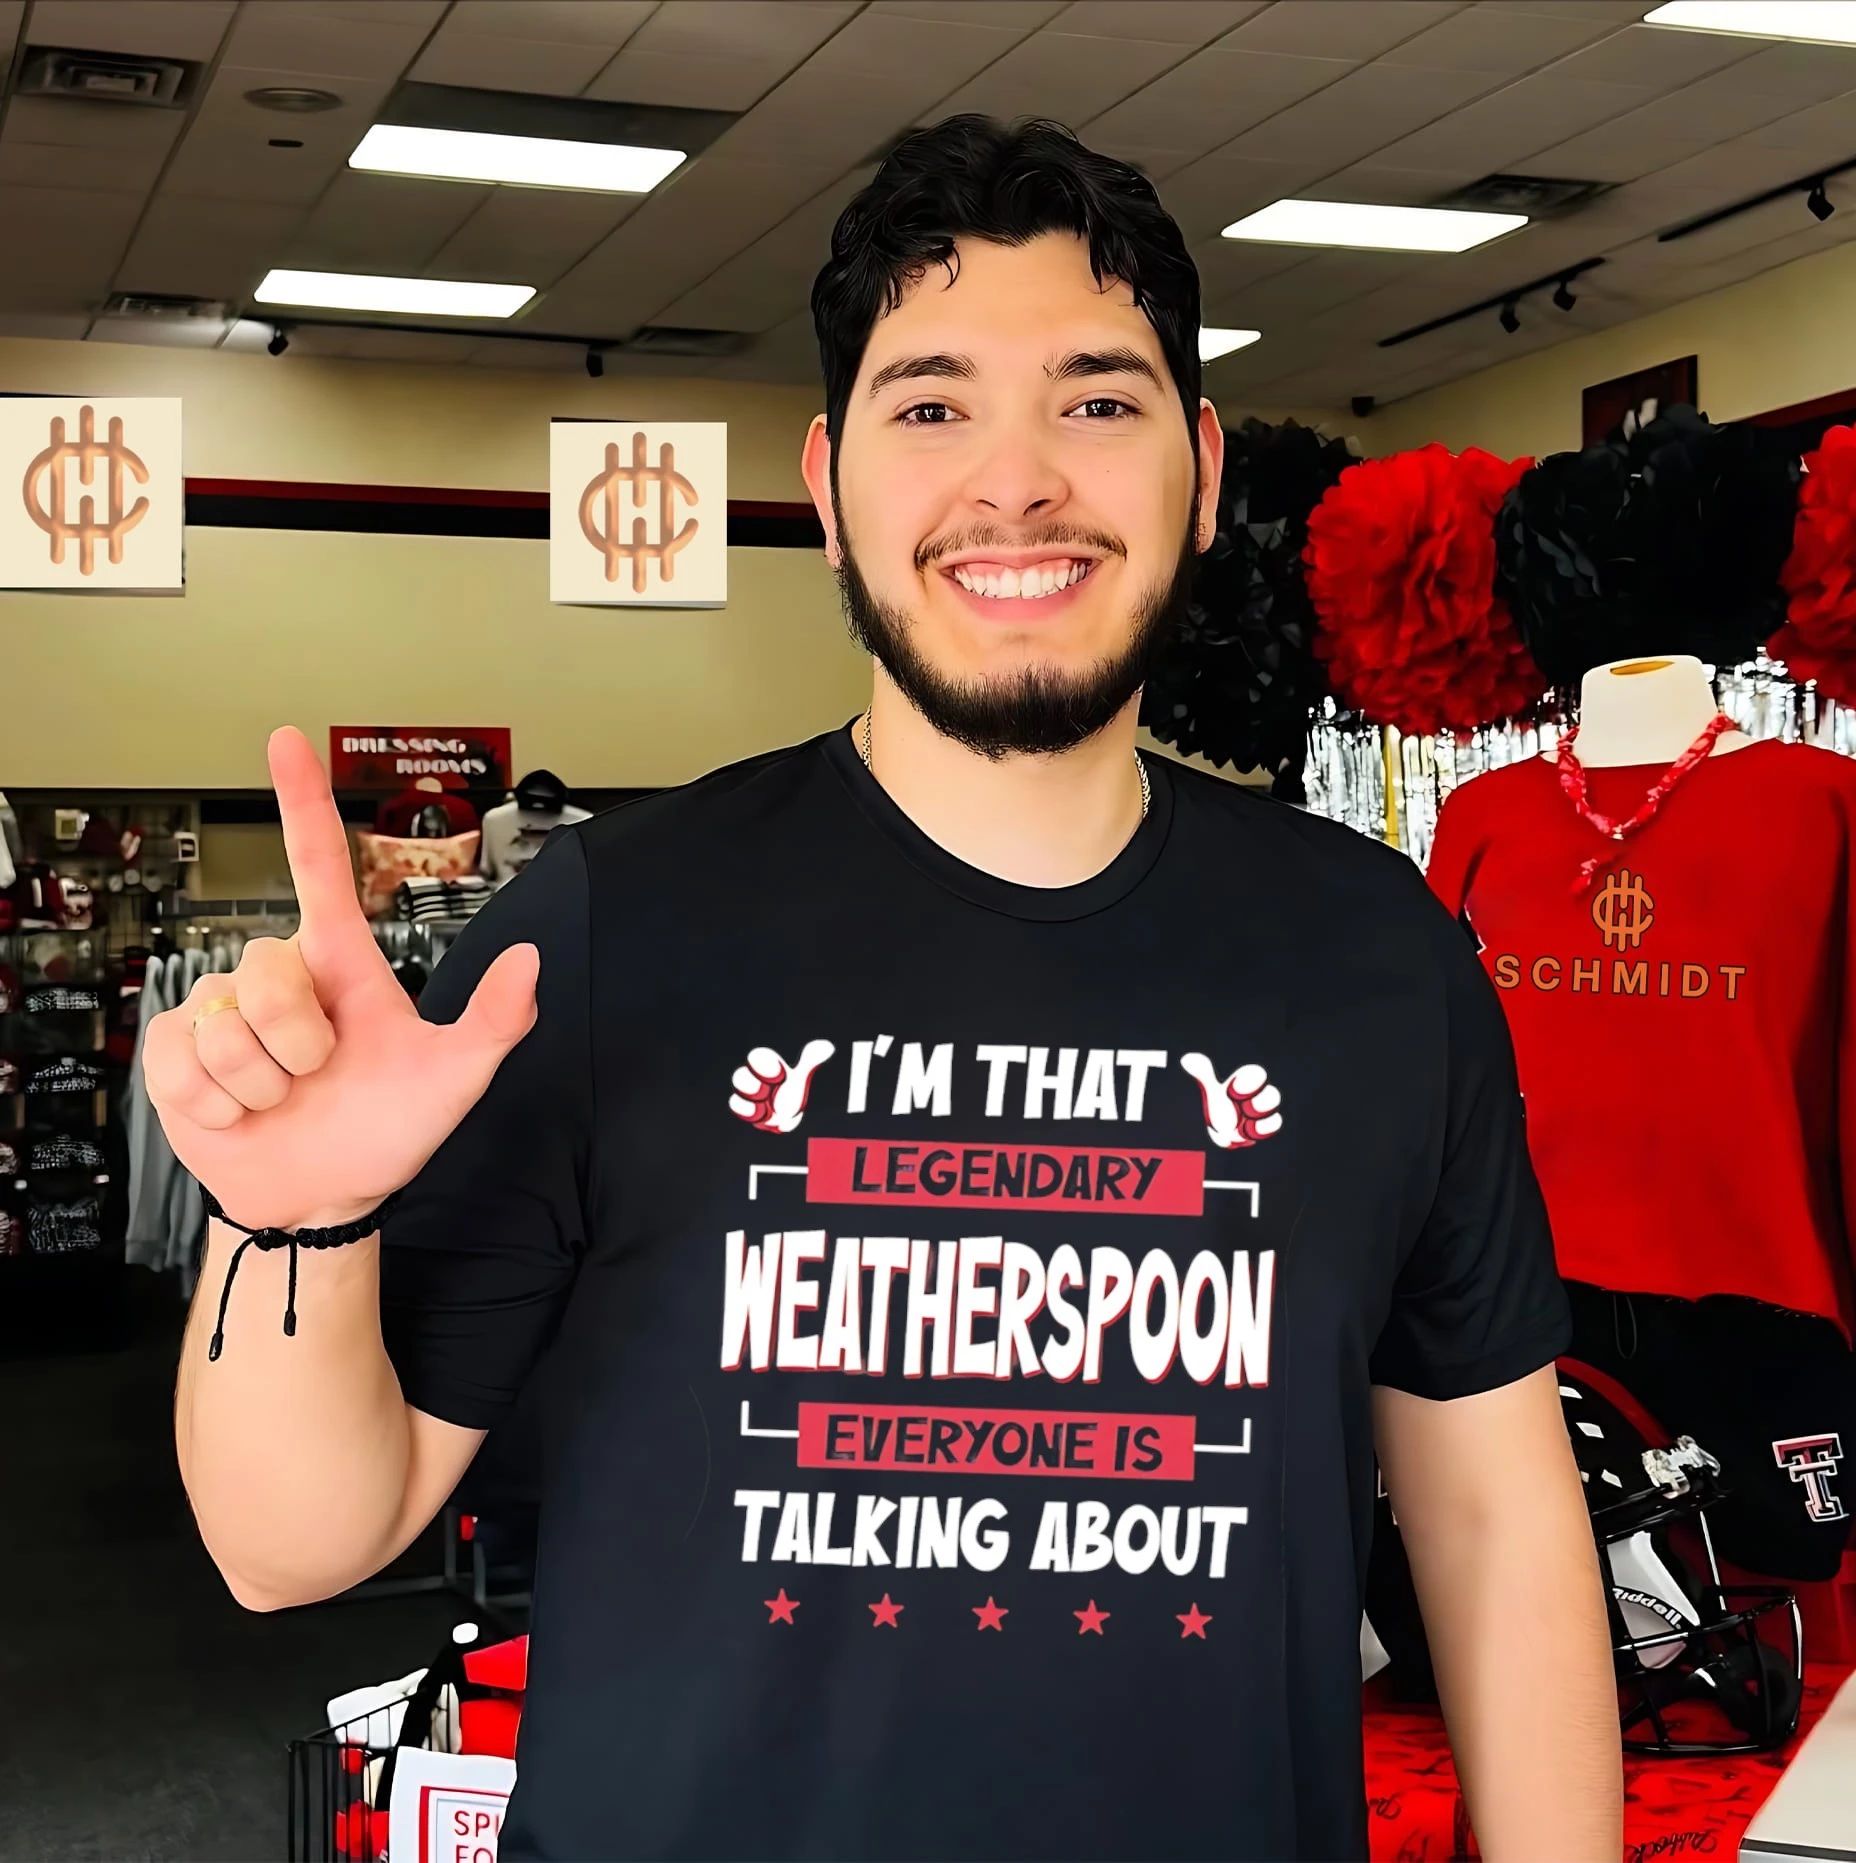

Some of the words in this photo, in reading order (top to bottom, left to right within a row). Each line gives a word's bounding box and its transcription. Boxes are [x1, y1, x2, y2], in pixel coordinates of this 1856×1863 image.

[396, 758, 487, 774] ROOMS
[1494, 954, 1746, 1000] SCHMIDT
[847, 1034, 954, 1117] I'M
[976, 1044, 1168, 1122] THAT
[852, 1147, 1163, 1201] LEGENDARY
[721, 1229, 1276, 1389] WEATHERSPOON
[825, 1414, 1097, 1470] EVERYONE
[1114, 1425, 1163, 1472] IS
[733, 1489, 1010, 1572] TALKING
[1029, 1500, 1249, 1578] ABOUT
